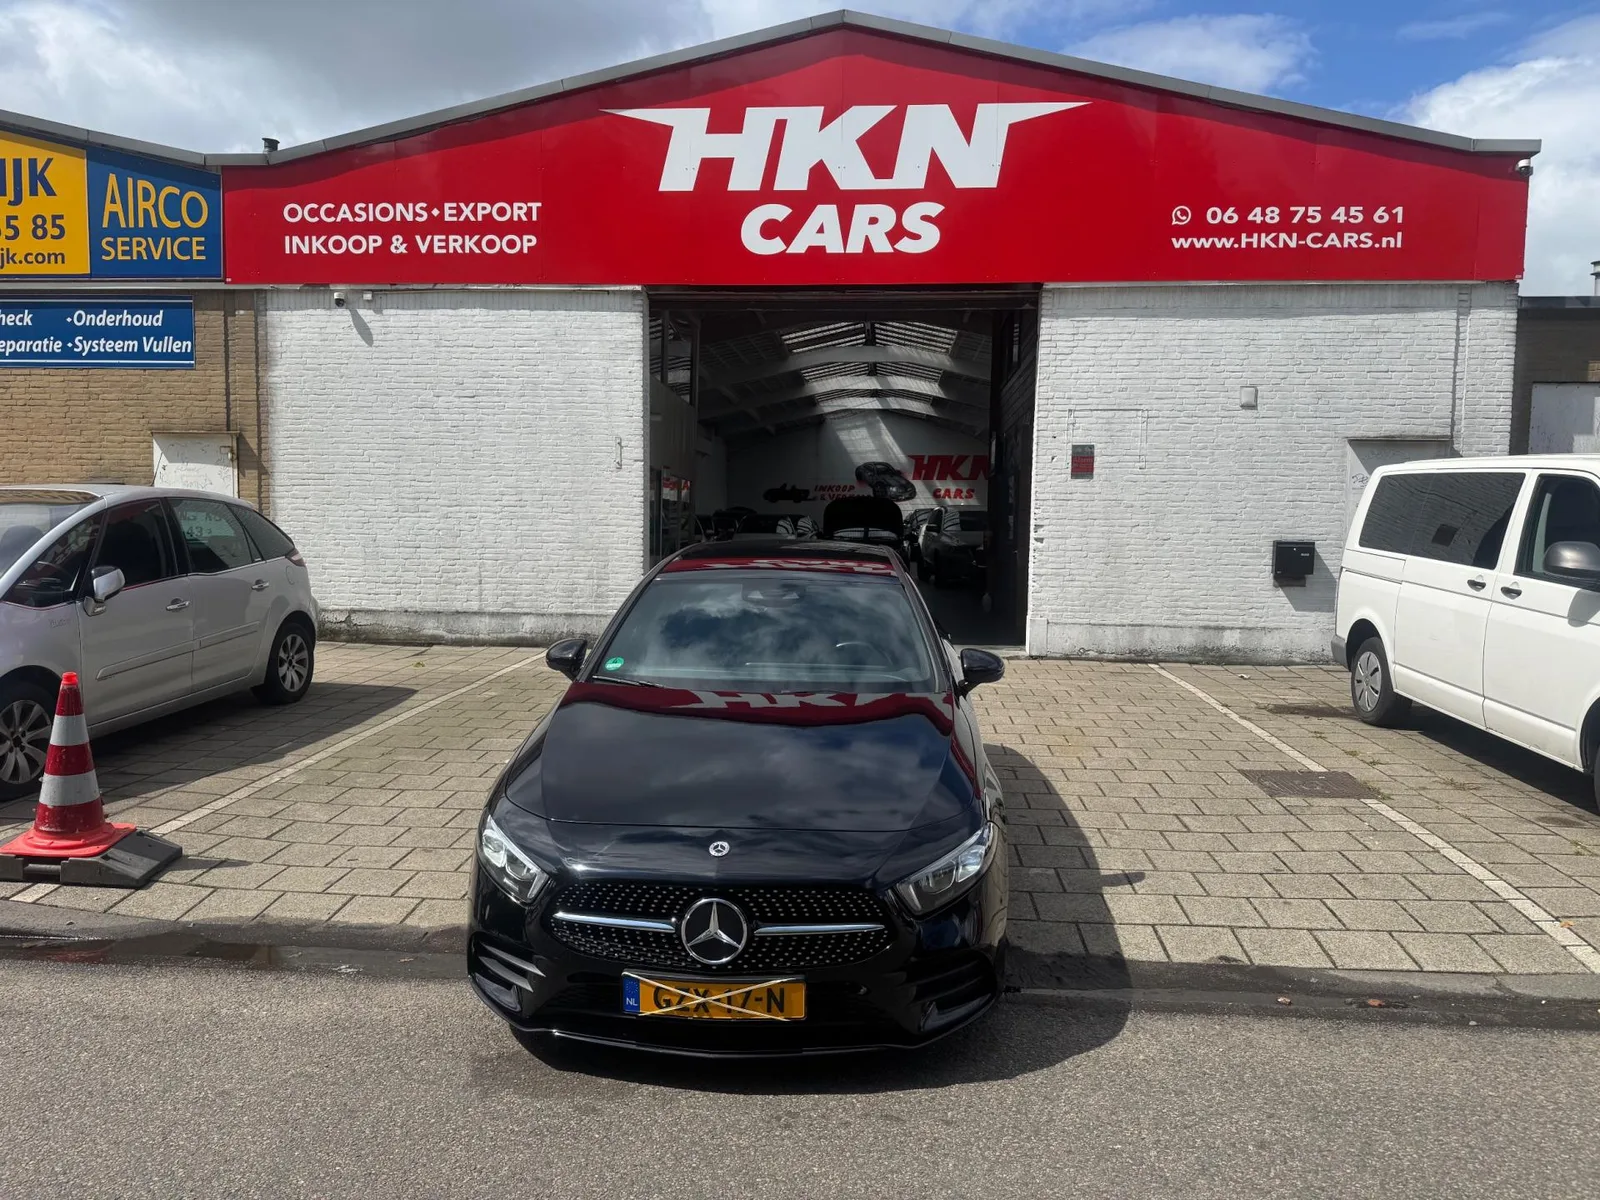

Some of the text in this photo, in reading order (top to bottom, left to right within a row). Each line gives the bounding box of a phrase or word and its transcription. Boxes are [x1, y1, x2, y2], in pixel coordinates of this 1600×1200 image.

[602, 101, 1092, 192] HKN
[102, 173, 209, 229] AIRCO
[1206, 206, 1404, 224] 06 48 75 45 61
[0, 214, 66, 240] 5 85
[740, 201, 945, 255] CARS
[101, 236, 206, 261] SERVICE
[284, 234, 537, 254] INKOOP & VERKOOP
[1171, 231, 1403, 249] www.HKN-CARS.nl
[142, 336, 192, 353] Vullen
[814, 484, 855, 493] INKOOP
[932, 487, 976, 500] CARS
[626, 997, 638, 1007] NL
